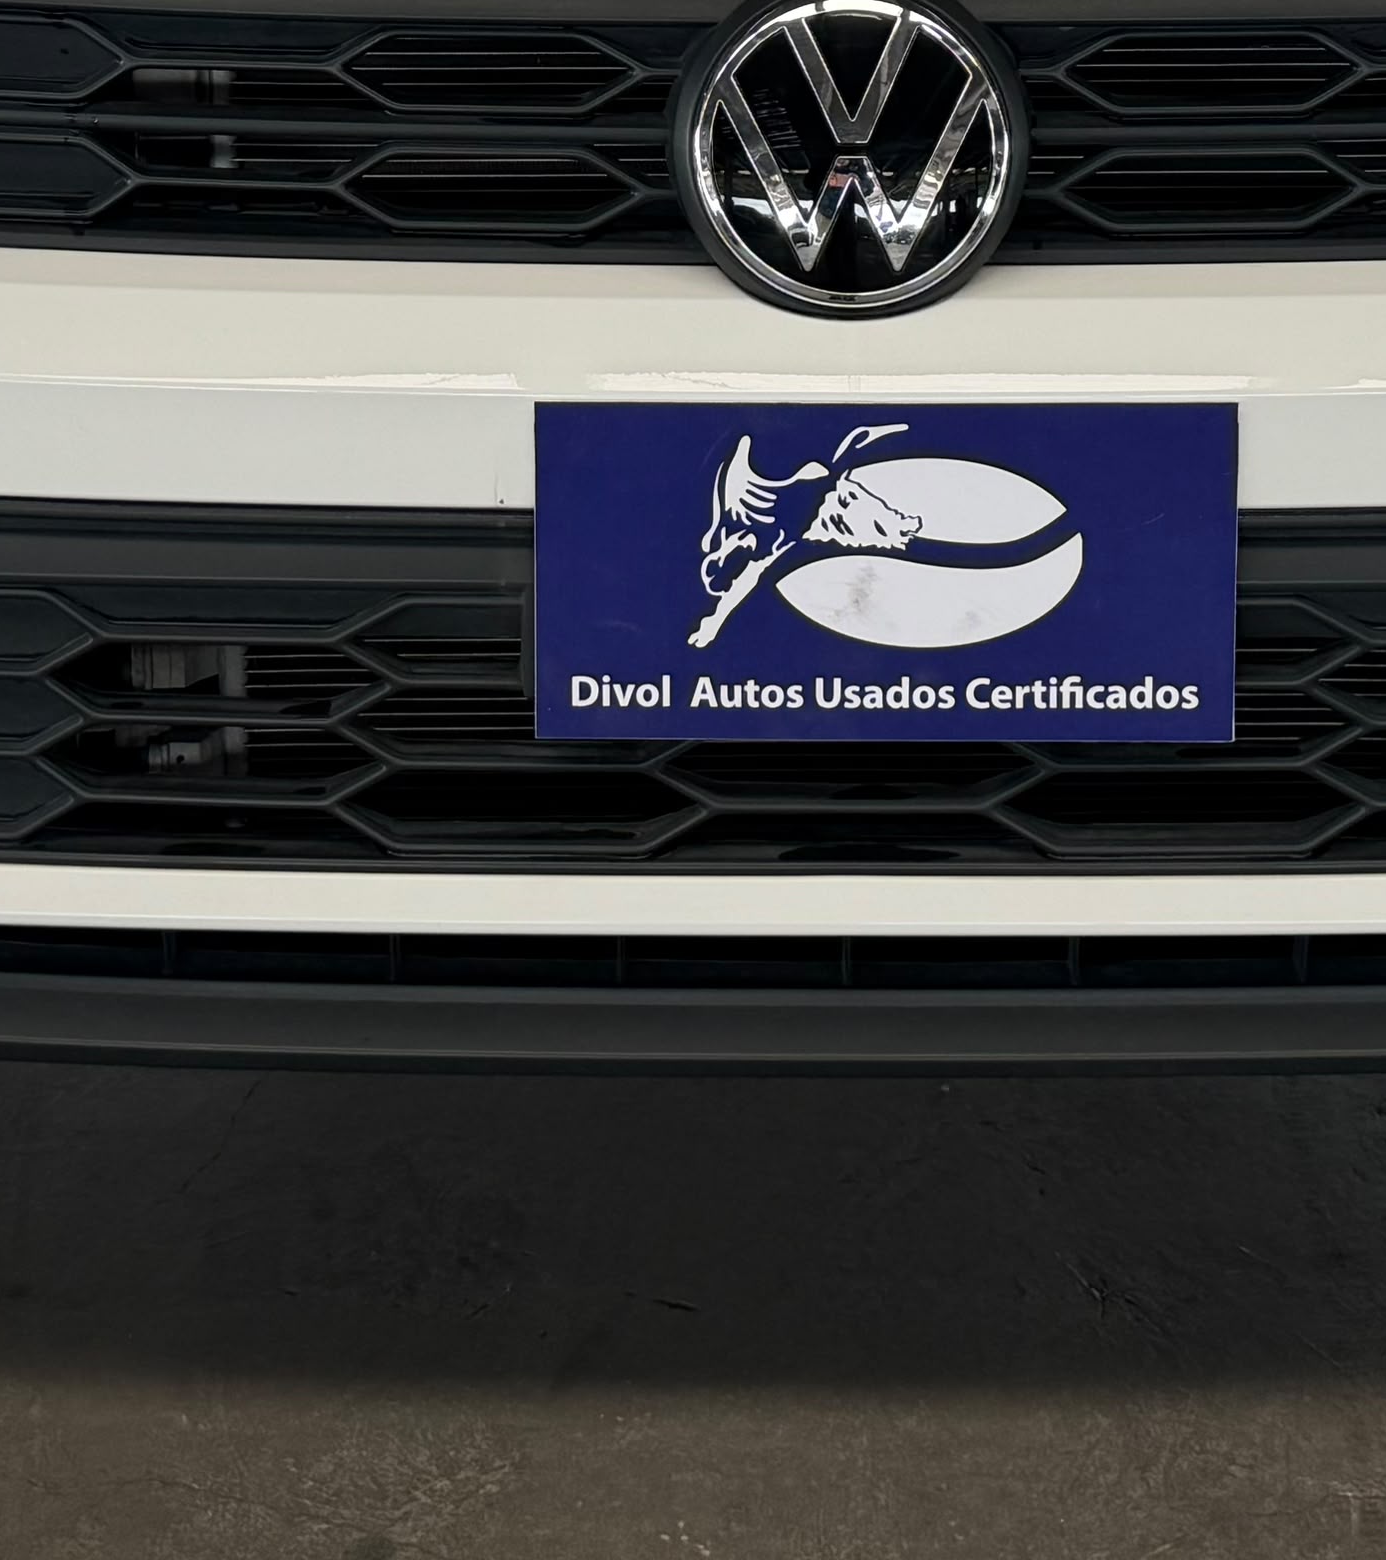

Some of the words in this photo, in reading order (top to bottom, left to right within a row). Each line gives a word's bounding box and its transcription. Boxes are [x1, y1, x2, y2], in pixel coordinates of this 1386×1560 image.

[570, 673, 672, 709] Divol
[689, 675, 805, 710] Autos
[814, 675, 957, 711] Usados
[964, 674, 1200, 711] Certificados
